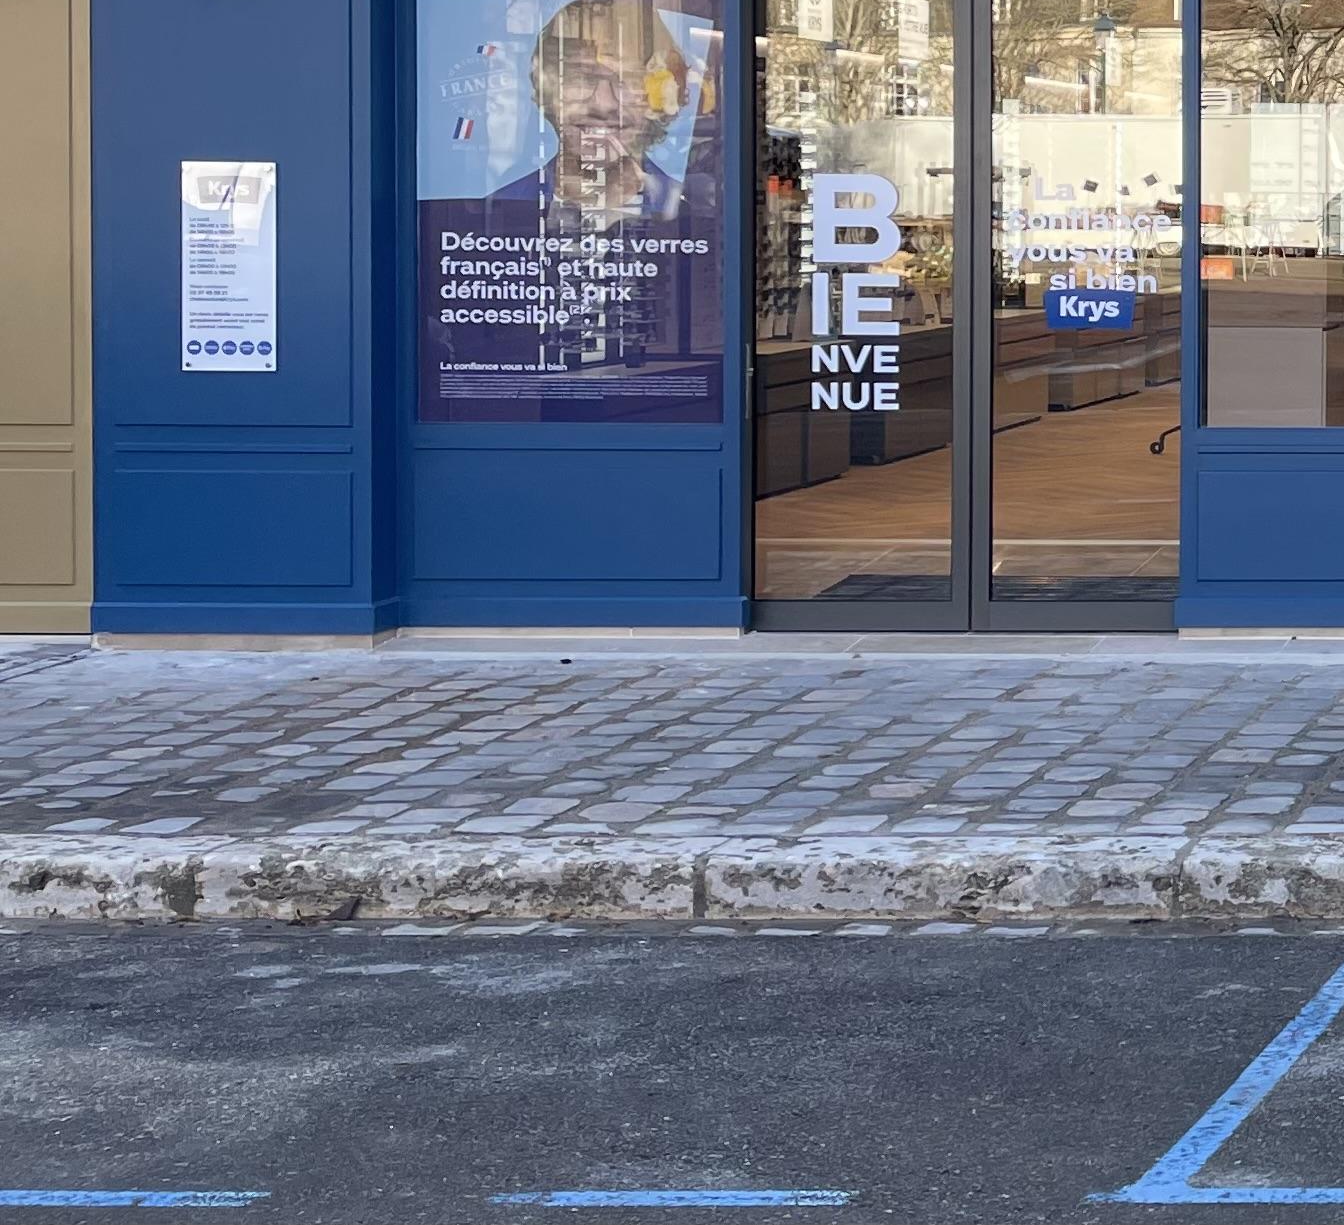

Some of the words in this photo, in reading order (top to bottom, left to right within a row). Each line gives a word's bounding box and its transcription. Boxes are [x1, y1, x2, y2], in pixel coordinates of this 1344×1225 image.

[1035, 178, 1076, 200] La
[812, 173, 901, 263] B
[440, 231, 574, 252] Découvrez
[579, 234, 624, 253] des
[631, 238, 709, 254] verres
[1098, 243, 1135, 263] va
[557, 260, 582, 277] et
[588, 259, 658, 278] haute
[1050, 267, 1077, 290] si
[1086, 267, 1157, 293] bien
[440, 280, 555, 300] définition
[561, 282, 577, 300] à
[583, 282, 632, 304] prix
[812, 272, 900, 336] IE
[1059, 295, 1120, 322] Krys
[440, 362, 452, 371] La
[453, 362, 499, 372] confiance
[500, 363, 523, 372] vous
[525, 364, 536, 372] va
[547, 363, 567, 372] bien
[811, 344, 899, 373] NVE
[811, 381, 899, 410] NUE
